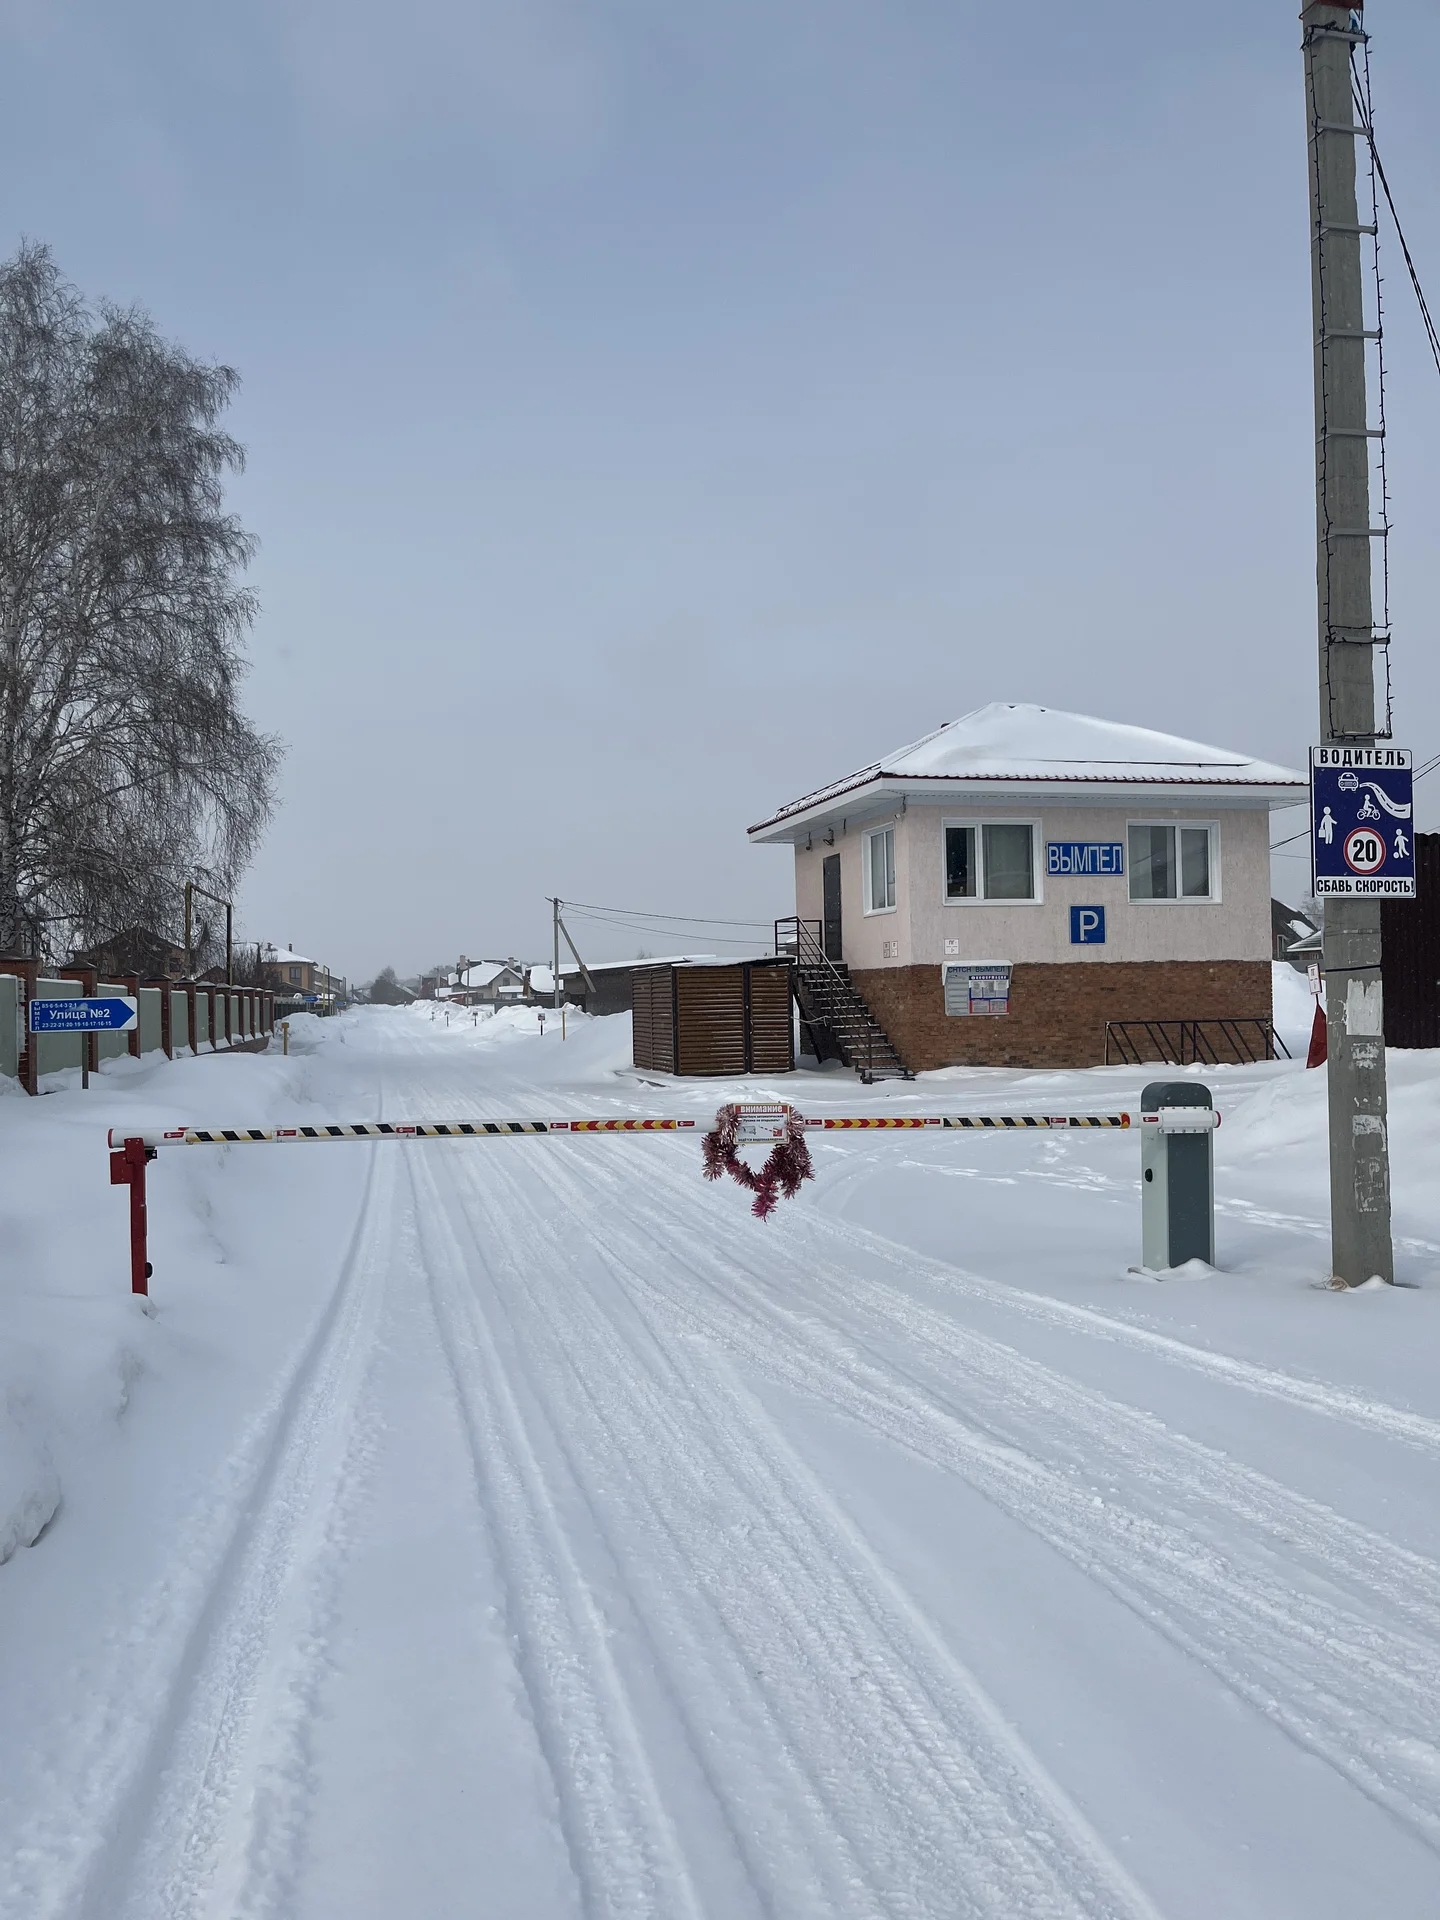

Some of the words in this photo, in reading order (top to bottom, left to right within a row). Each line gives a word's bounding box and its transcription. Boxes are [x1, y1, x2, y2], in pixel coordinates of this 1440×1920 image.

[1319, 748, 1406, 767] ВОДИТЕЛЬ
[1048, 845, 1123, 872] ВЫМПЕЛ
[1352, 839, 1377, 862] 20
[1317, 879, 1352, 892] СБАВЬ
[1355, 879, 1414, 893] СКОРОСТЬ!
[1079, 910, 1099, 941] P
[49, 1009, 87, 1020] Улица
[90, 1008, 110, 1018] №2
